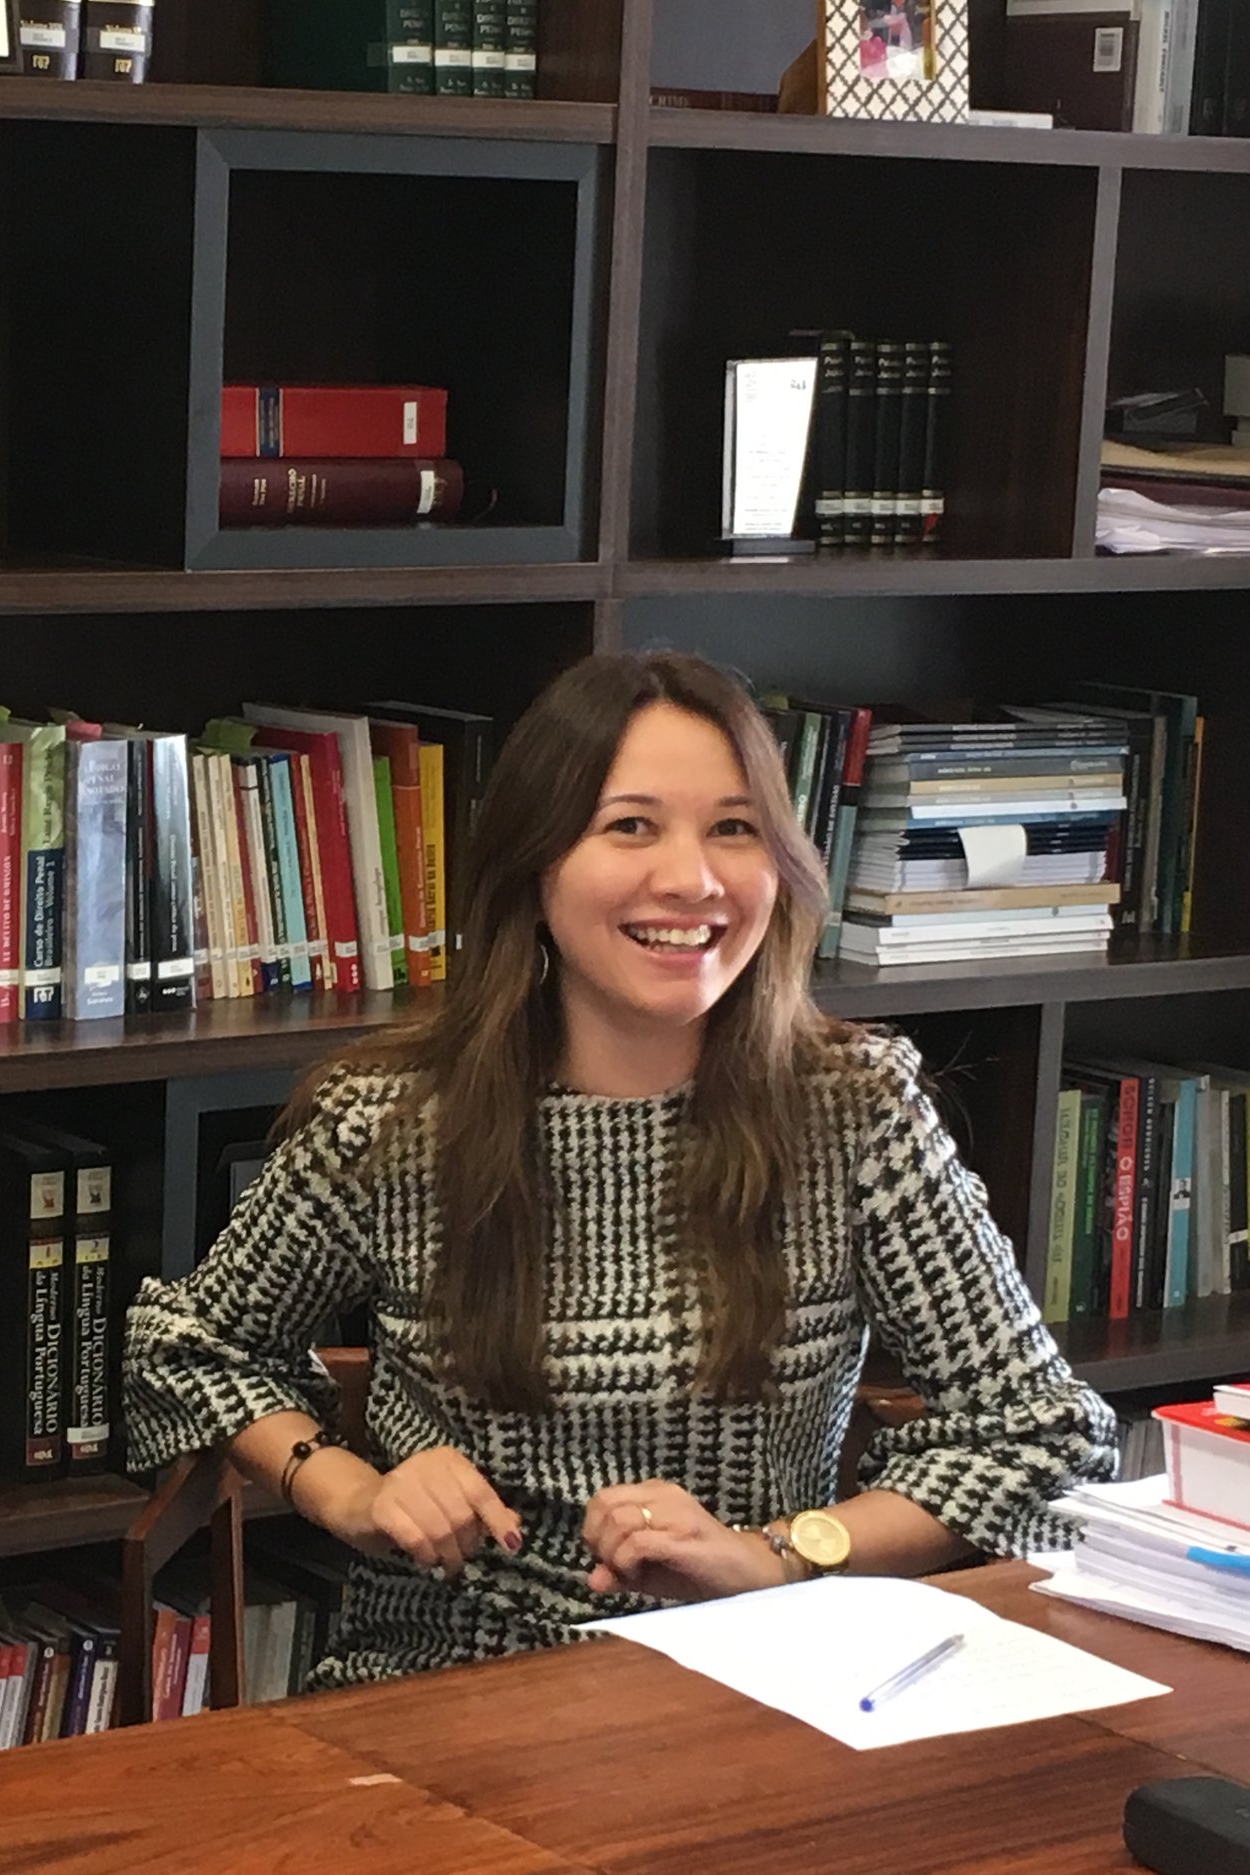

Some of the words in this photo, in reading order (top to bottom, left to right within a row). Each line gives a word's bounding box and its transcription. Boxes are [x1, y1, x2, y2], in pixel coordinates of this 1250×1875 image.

[34, 856, 46, 884] Penal
[34, 886, 45, 922] Direito
[34, 923, 44, 937] de
[34, 938, 44, 968] Curso
[1118, 1155, 1134, 1171] O
[35, 1270, 47, 1286] da
[50, 1271, 60, 1320] Moderno
[82, 1265, 93, 1281] da
[94, 1265, 106, 1315] Moderno
[29, 1287, 48, 1342] Língua
[75, 1282, 95, 1337] Língua
[28, 1346, 47, 1435] Portuguesa
[45, 1322, 63, 1433] DICIONÁRIO
[74, 1340, 93, 1428] Portuguesa
[90, 1316, 108, 1425] DICIONÁRIO
